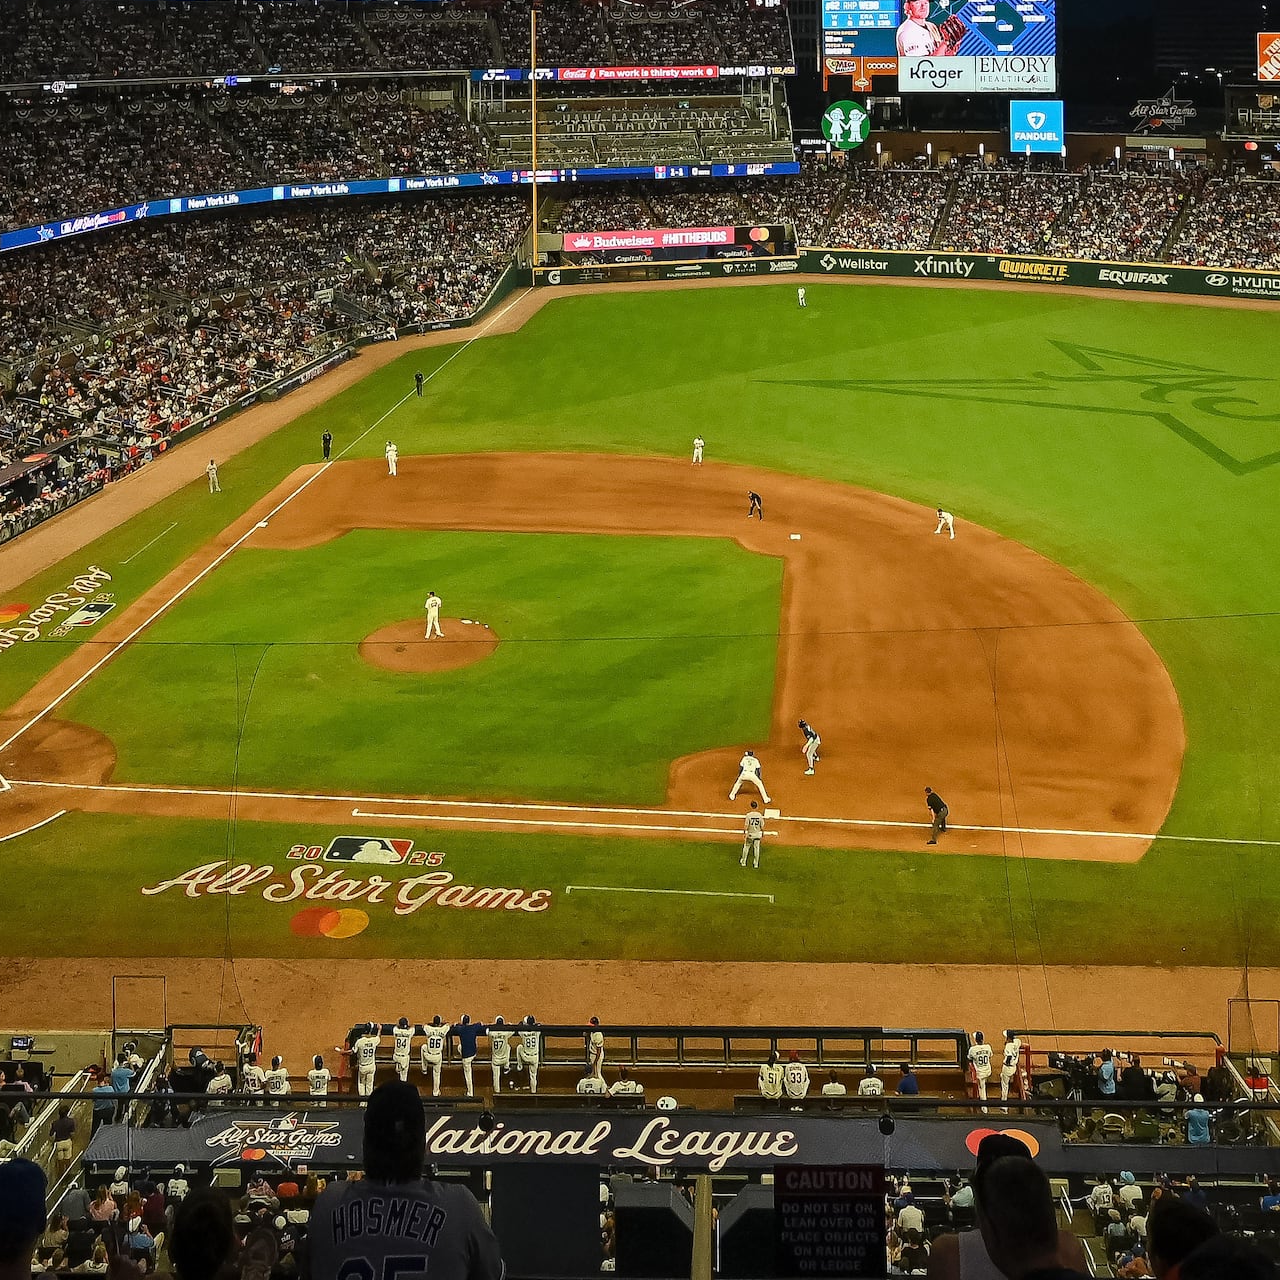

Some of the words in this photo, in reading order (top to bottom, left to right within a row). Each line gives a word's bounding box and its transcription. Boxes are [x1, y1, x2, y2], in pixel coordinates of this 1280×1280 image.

[599, 69, 617, 78] Fan
[618, 68, 640, 78] work
[641, 68, 649, 77] is
[651, 68, 677, 79] thirsty
[679, 67, 704, 76] work
[980, 57, 1051, 73] EMORY
[910, 59, 963, 89] Kroger
[563, 114, 607, 132] HANK
[615, 112, 663, 131] AARON
[671, 110, 748, 130] TERRACE
[1014, 132, 1059, 142] FANDUEL
[291, 188, 311, 197] New
[312, 186, 331, 196] York
[332, 184, 348, 194] Life
[593, 236, 654, 248] Budweiser
[662, 231, 727, 244] #HITTHEBUDS
[839, 258, 888, 270] Wellstar
[914, 256, 975, 277] xfinity
[999, 260, 1069, 277] QUIKRETE
[1099, 269, 1170, 285] EQUIFAX
[28, 593, 86, 626] Star
[287, 845, 321, 860] 20
[409, 851, 446, 867] 25
[142, 860, 273, 898] All
[263, 864, 393, 903] Star
[395, 871, 551, 916] Game
[206, 1128, 249, 1147] All
[250, 1128, 289, 1145] Star
[288, 1131, 342, 1147] Game
[614, 1116, 798, 1171] League
[785, 1171, 872, 1189] CAUTION
[782, 1203, 800, 1213] DO
[803, 1203, 828, 1213] NOT
[831, 1203, 850, 1213] SIT
[855, 1203, 876, 1215] ON,
[330, 1197, 447, 1248] HOSMER
[784, 1217, 816, 1227] LEAN
[819, 1217, 853, 1228] OVER
[857, 1217, 874, 1227] OR
[781, 1231, 822, 1241] PLACE
[824, 1231, 879, 1241] OBJECTS
